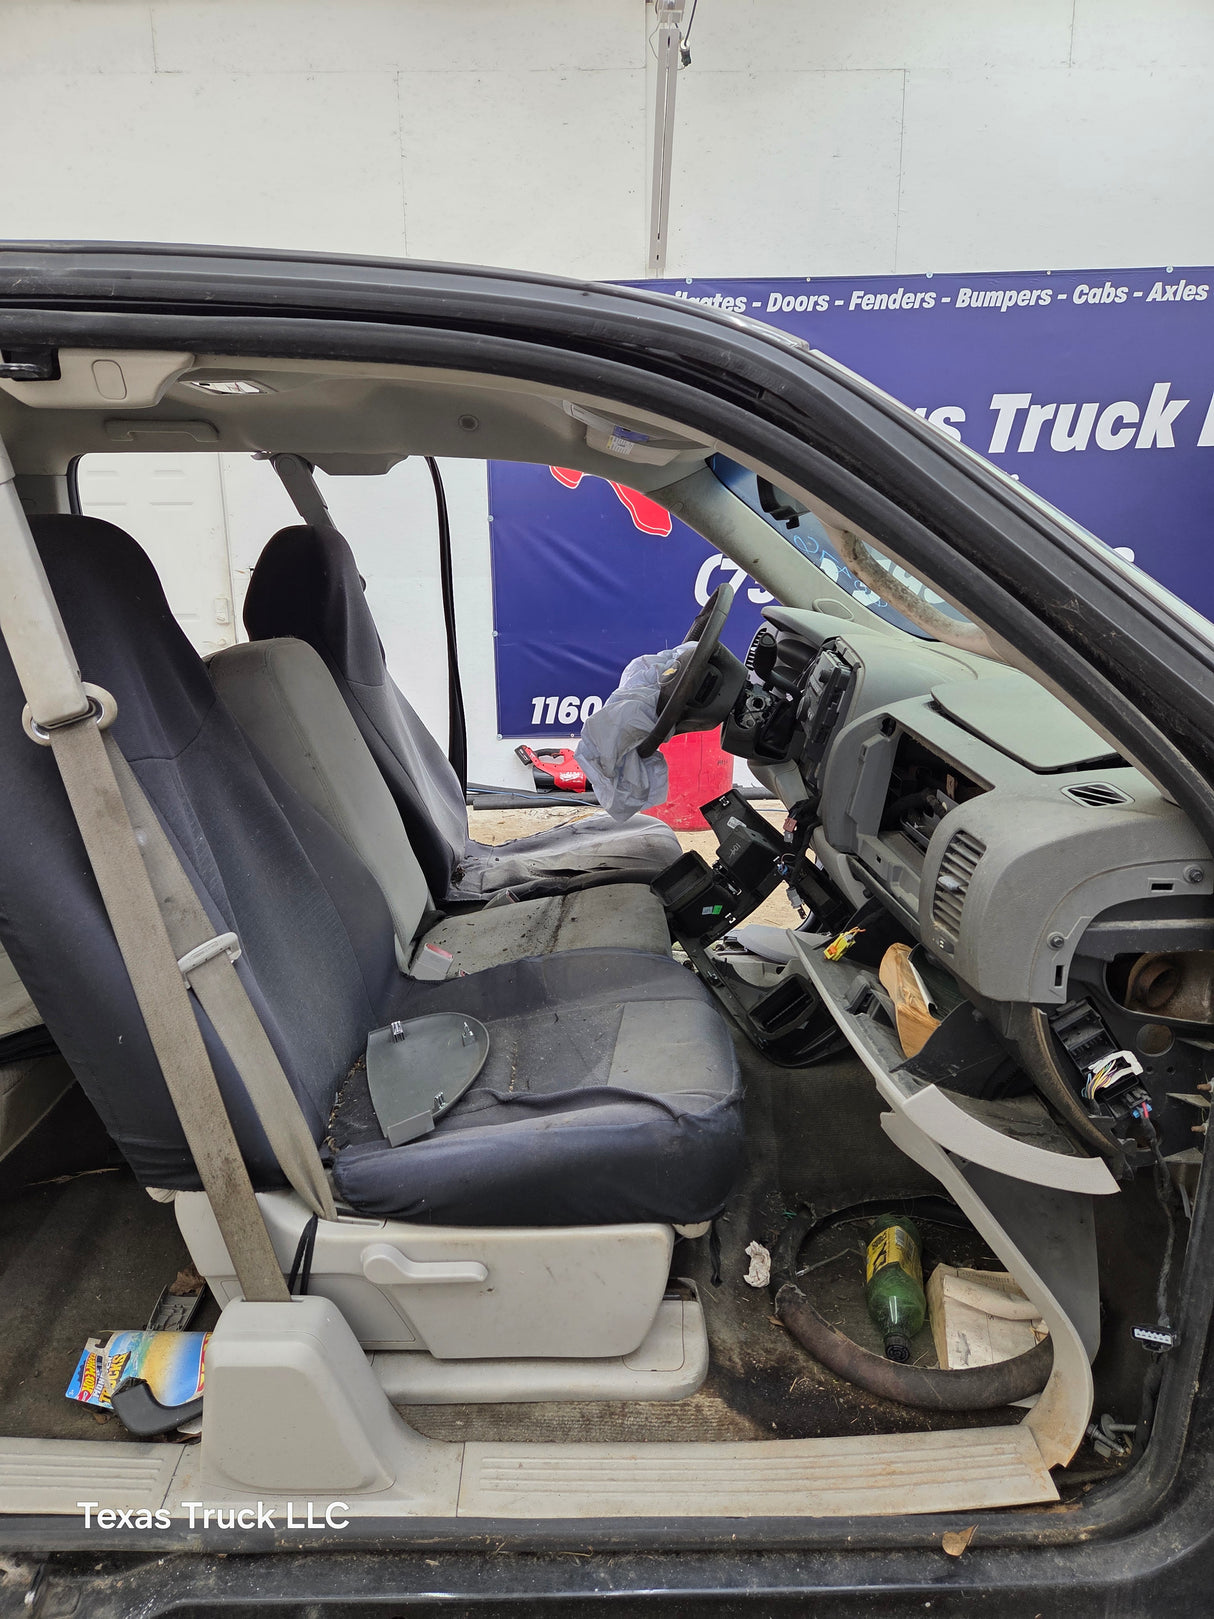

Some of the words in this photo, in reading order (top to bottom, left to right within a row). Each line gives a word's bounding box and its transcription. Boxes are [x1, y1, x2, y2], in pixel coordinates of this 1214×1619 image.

[766, 292, 831, 312] Doors
[848, 288, 936, 311] Fenders
[955, 287, 1053, 313] Bumpers
[1072, 281, 1129, 304] Cabs
[1145, 279, 1210, 302] Axles
[987, 381, 1191, 454] Truck
[531, 695, 603, 725] 1160
